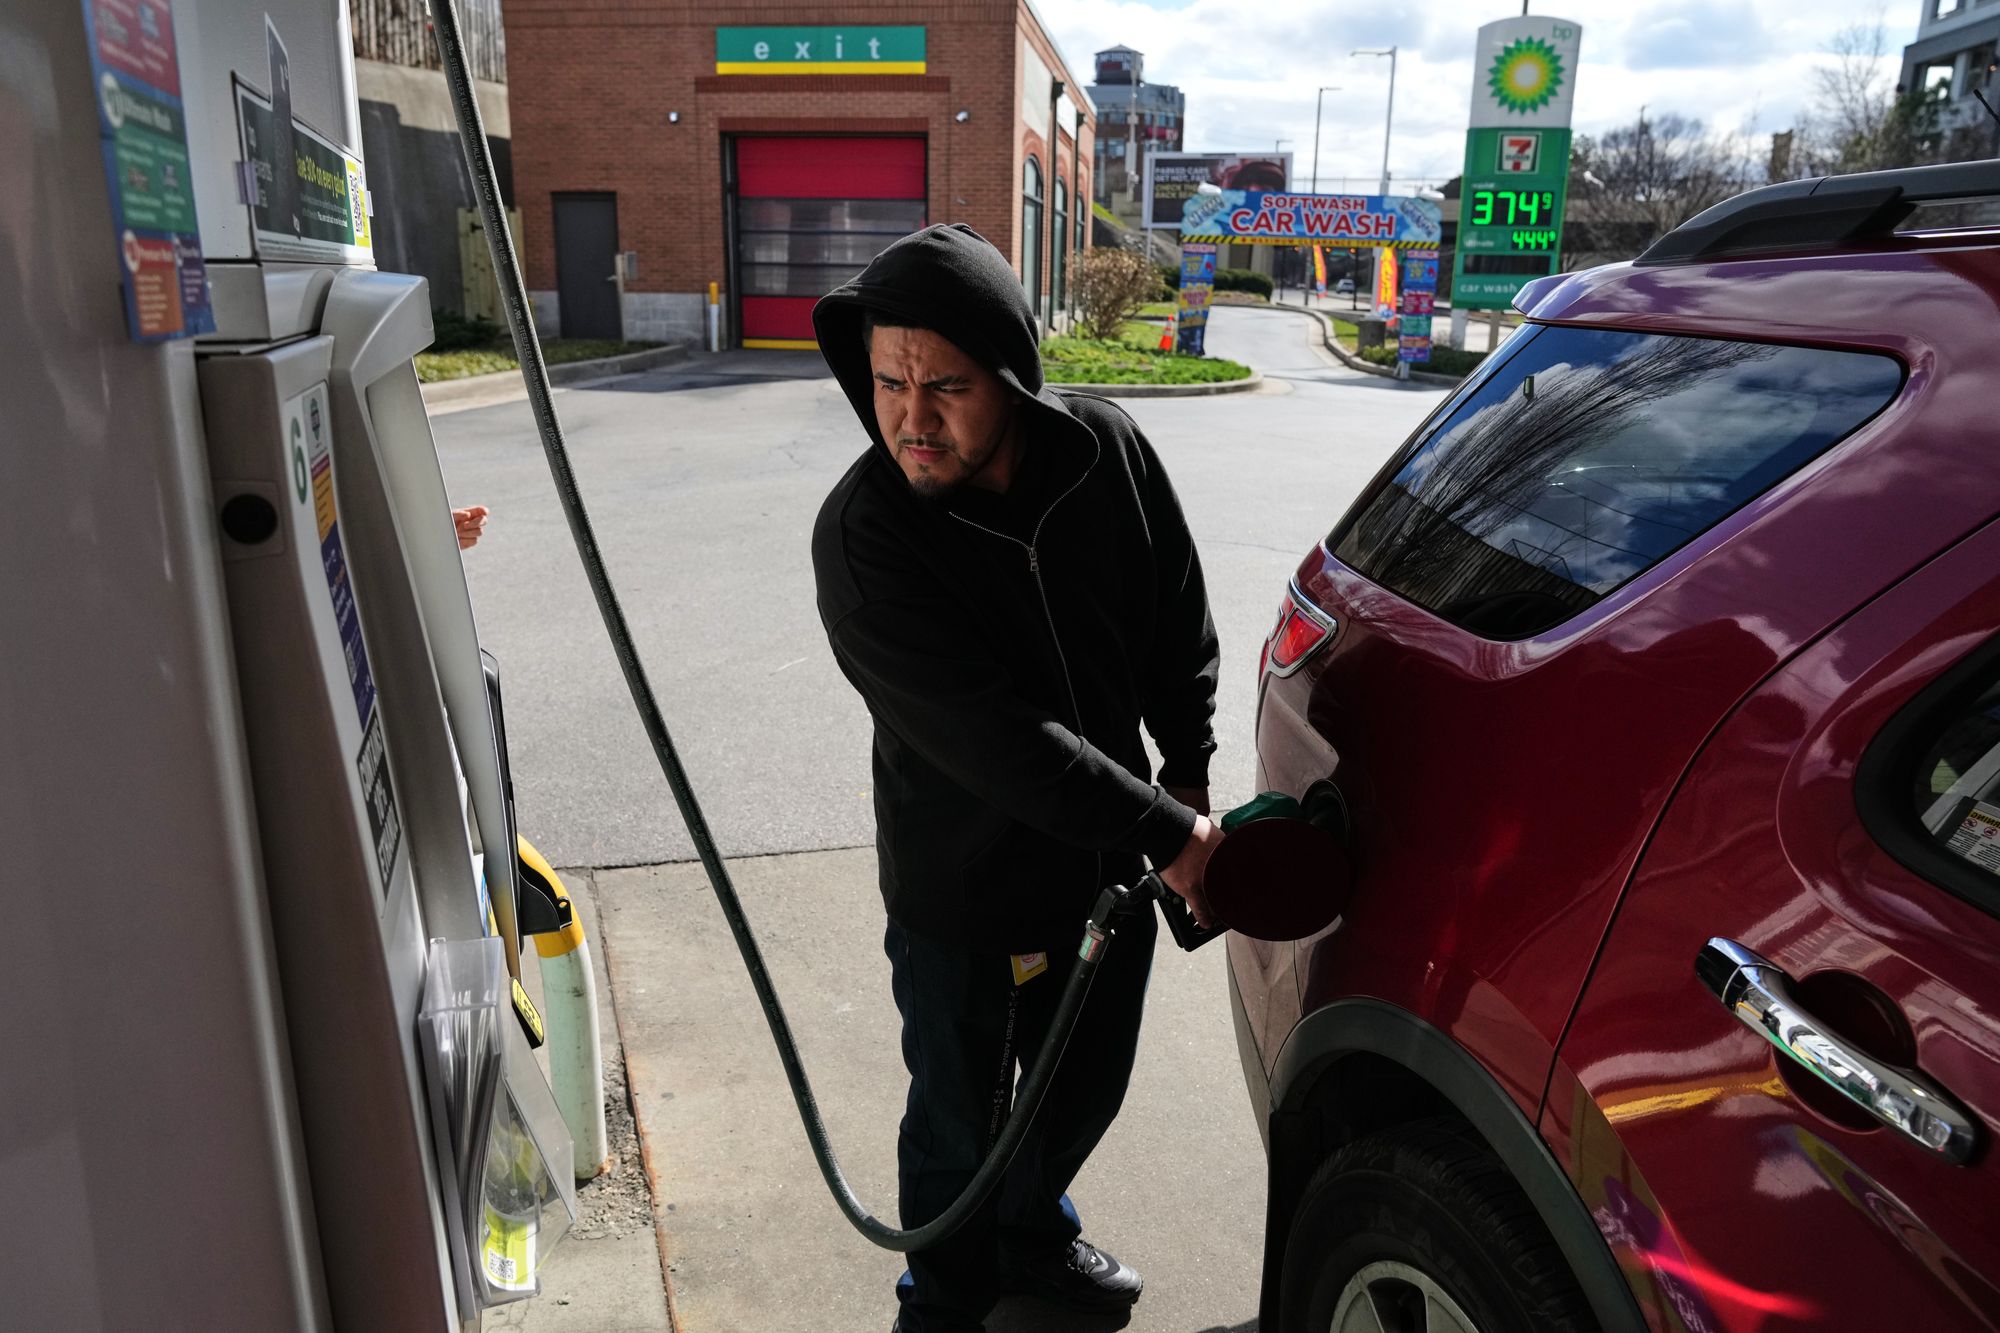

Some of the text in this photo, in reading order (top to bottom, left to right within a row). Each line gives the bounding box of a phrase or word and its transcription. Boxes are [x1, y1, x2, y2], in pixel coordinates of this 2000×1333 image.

[1552, 22, 1573, 42] bp
[753, 35, 881, 60] exit
[448, 56, 466, 96] STEELFLEX
[491, 221, 502, 241] MADE
[498, 250, 507, 265] USA
[1507, 138, 1532, 171] 7
[1263, 195, 1366, 211] SOFTWASH
[1231, 210, 1295, 234] CAR
[1303, 213, 1396, 236] WASH
[1460, 282, 1518, 293] car wash
[516, 324, 534, 359] STEELFLEX
[290, 416, 308, 505] 6
